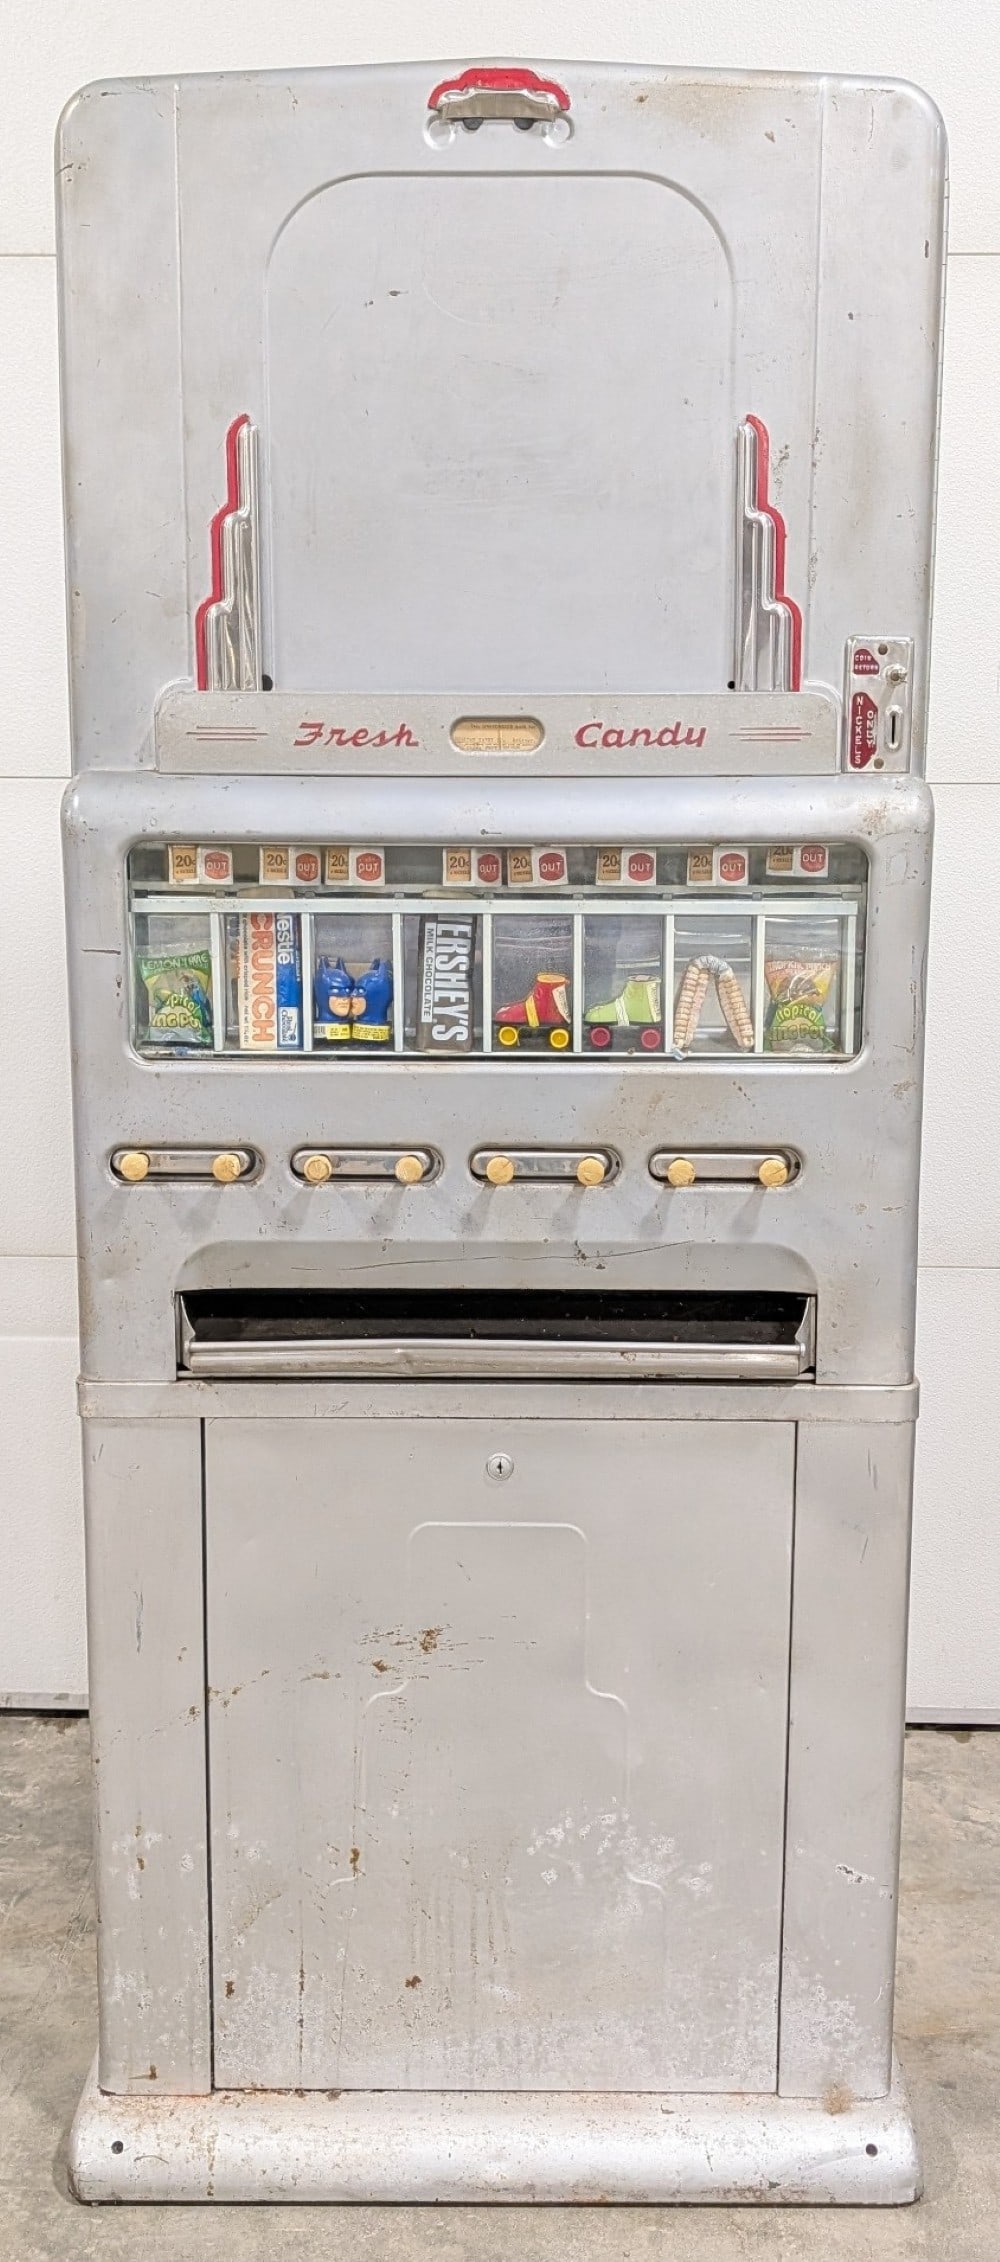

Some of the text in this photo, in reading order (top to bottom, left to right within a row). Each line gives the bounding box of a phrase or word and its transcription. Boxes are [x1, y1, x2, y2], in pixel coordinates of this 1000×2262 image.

[854, 696, 864, 764] NICKELS
[866, 710, 875, 748] ONLY
[293, 721, 707, 748] Fresh Candy
[802, 853, 823, 863] OUT
[206, 861, 227, 871] OUT
[297, 862, 316, 872] OUT
[358, 862, 379, 872] OUT
[479, 863, 497, 873] OUT
[540, 861, 561, 873] OUT
[630, 863, 650, 872] OUT
[721, 863, 741, 872] OUT
[250, 912, 275, 1042] CRUNCH
[424, 927, 434, 1017] MILK CHOCOLATE
